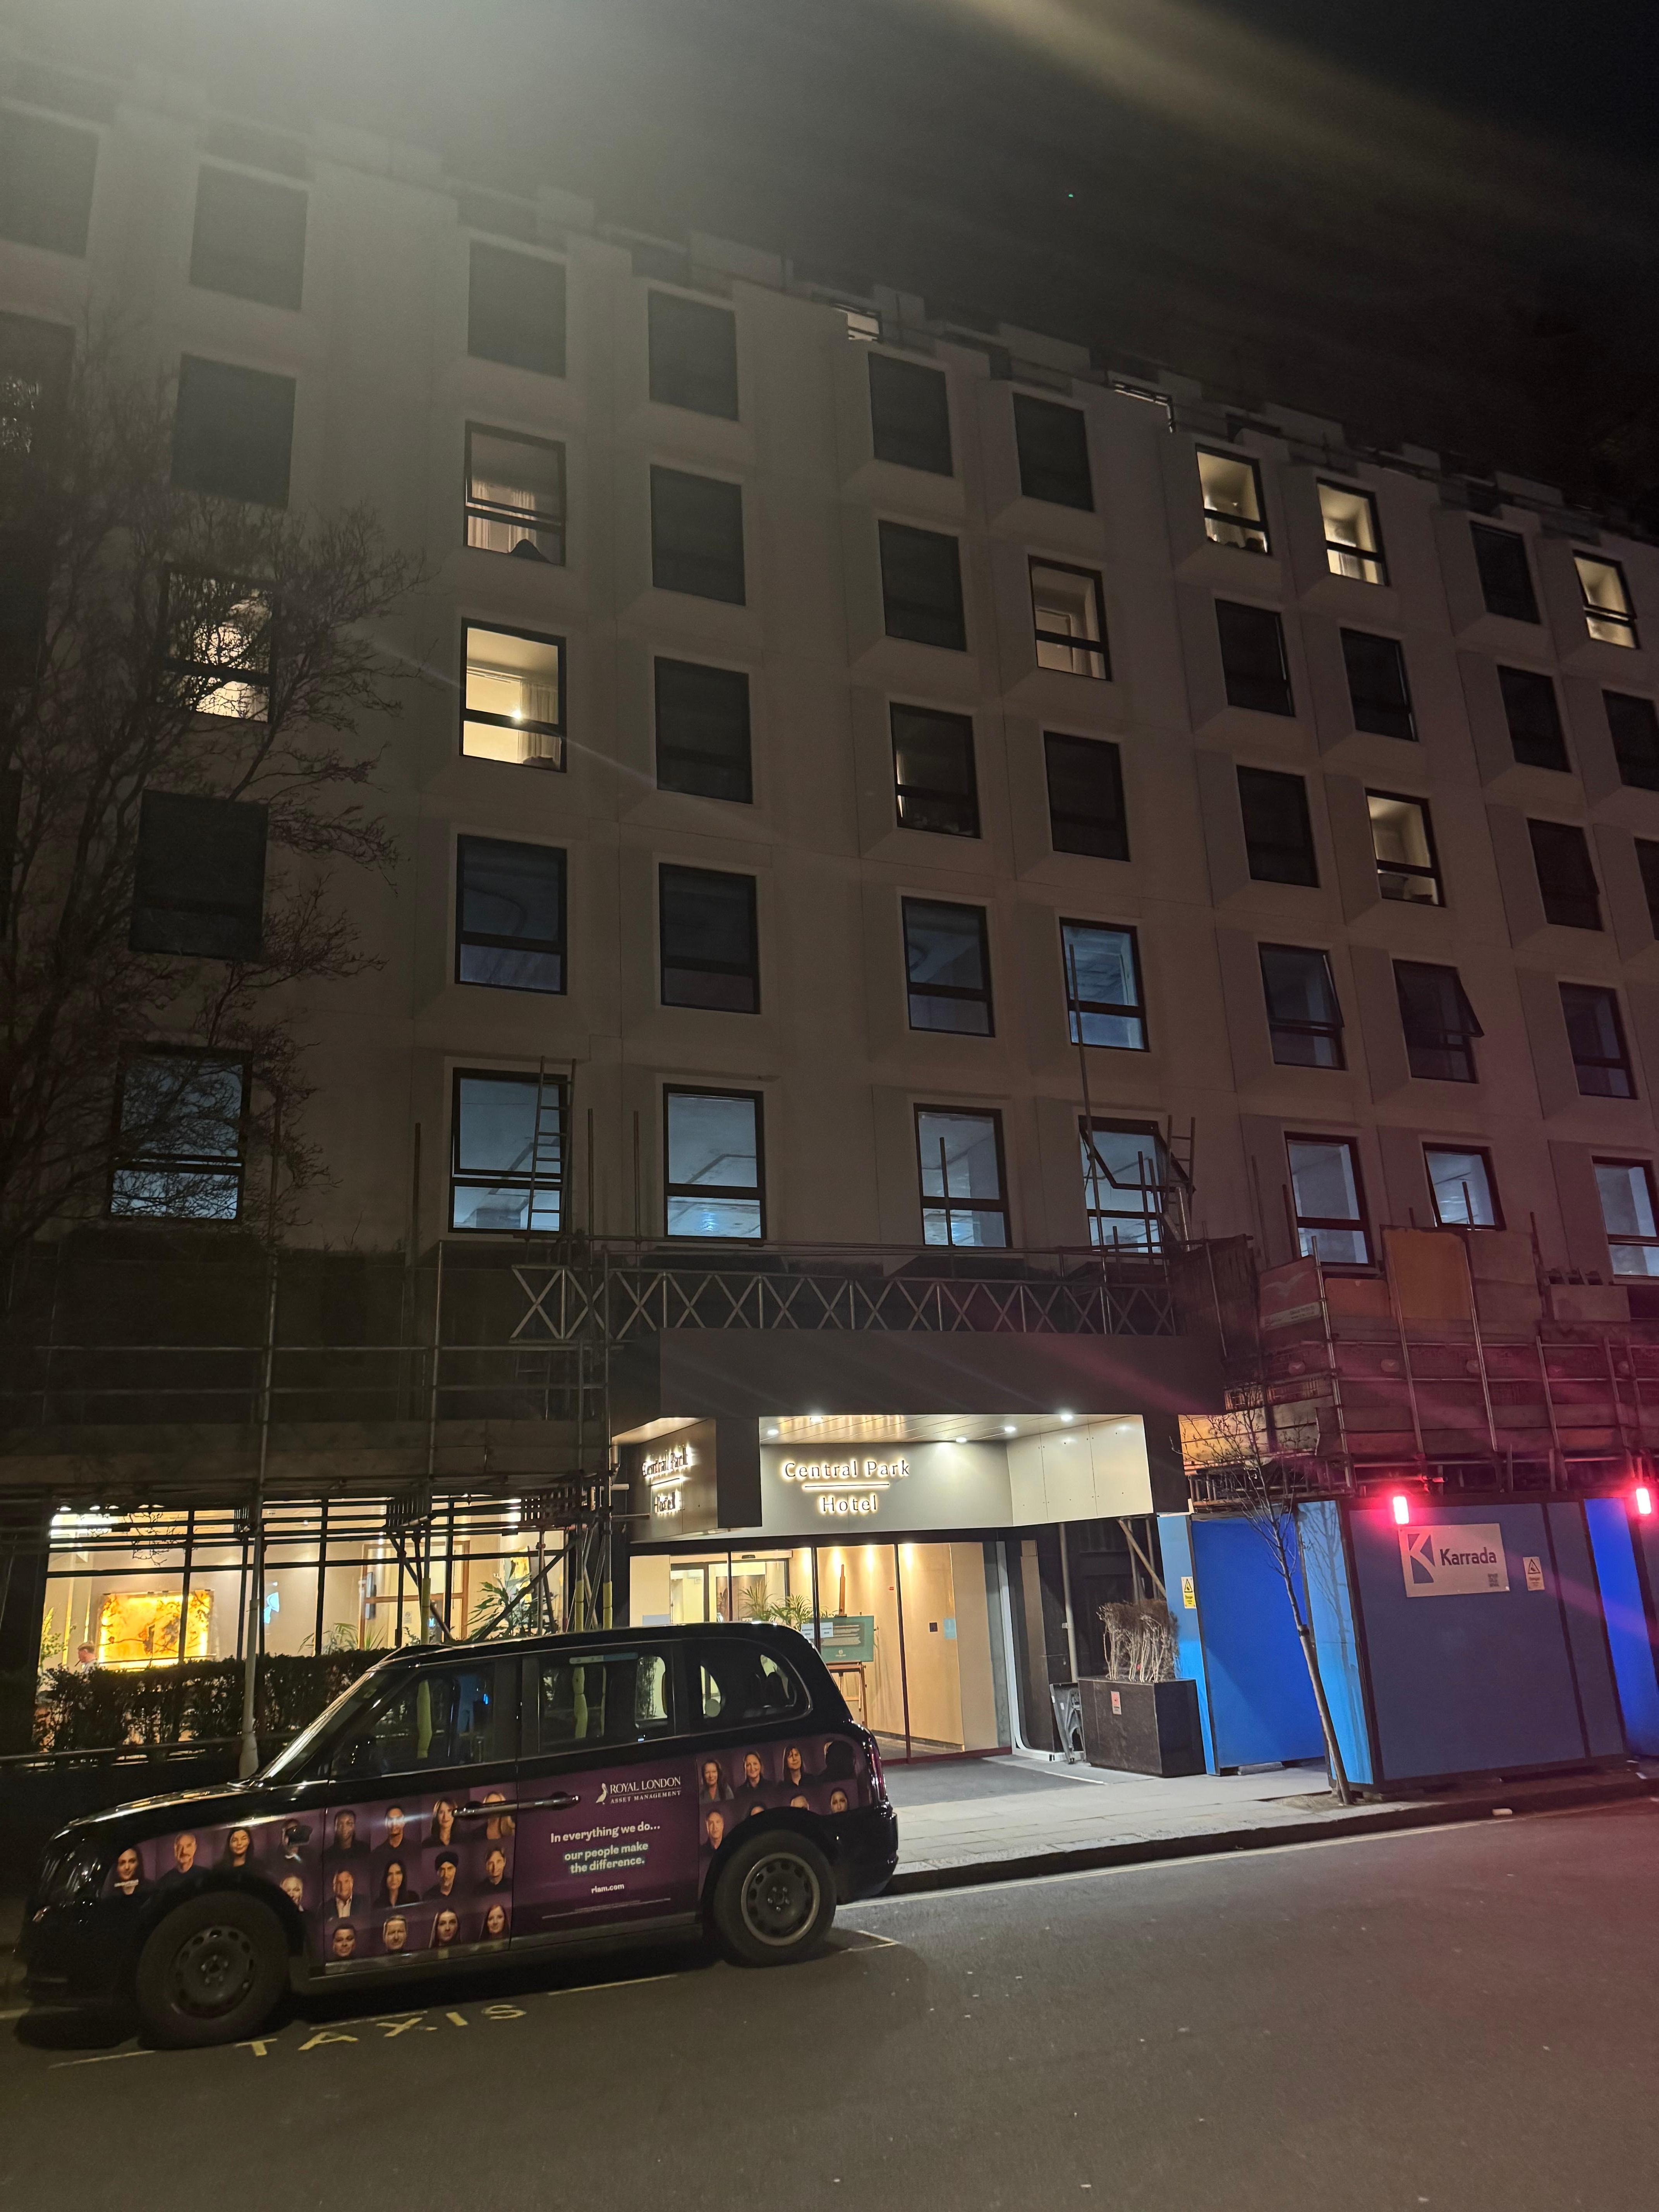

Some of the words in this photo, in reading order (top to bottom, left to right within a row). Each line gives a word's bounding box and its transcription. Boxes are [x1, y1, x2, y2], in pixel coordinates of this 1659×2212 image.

[785, 1460, 858, 1477] Central
[867, 1460, 910, 1475] Park
[823, 1494, 877, 1512] Hotel
[1440, 1547, 1497, 1566] Karrada
[610, 1781, 640, 1794] ROYAL
[641, 1776, 681, 1790] LONDON
[611, 1796, 632, 1804] ASSET
[634, 1790, 681, 1801] MANAGEMENT
[550, 1832, 561, 1843] In
[562, 1826, 620, 1841] everything
[621, 1825, 636, 1834] we
[637, 1821, 660, 1831] do...
[564, 1851, 583, 1861] our
[584, 1844, 620, 1861] people
[621, 1841, 649, 1853] make
[570, 1863, 588, 1874] the
[589, 1856, 645, 1871] difference.
[591, 1884, 625, 1894] rlam.com
[235, 2004, 526, 2057] TAXIS
